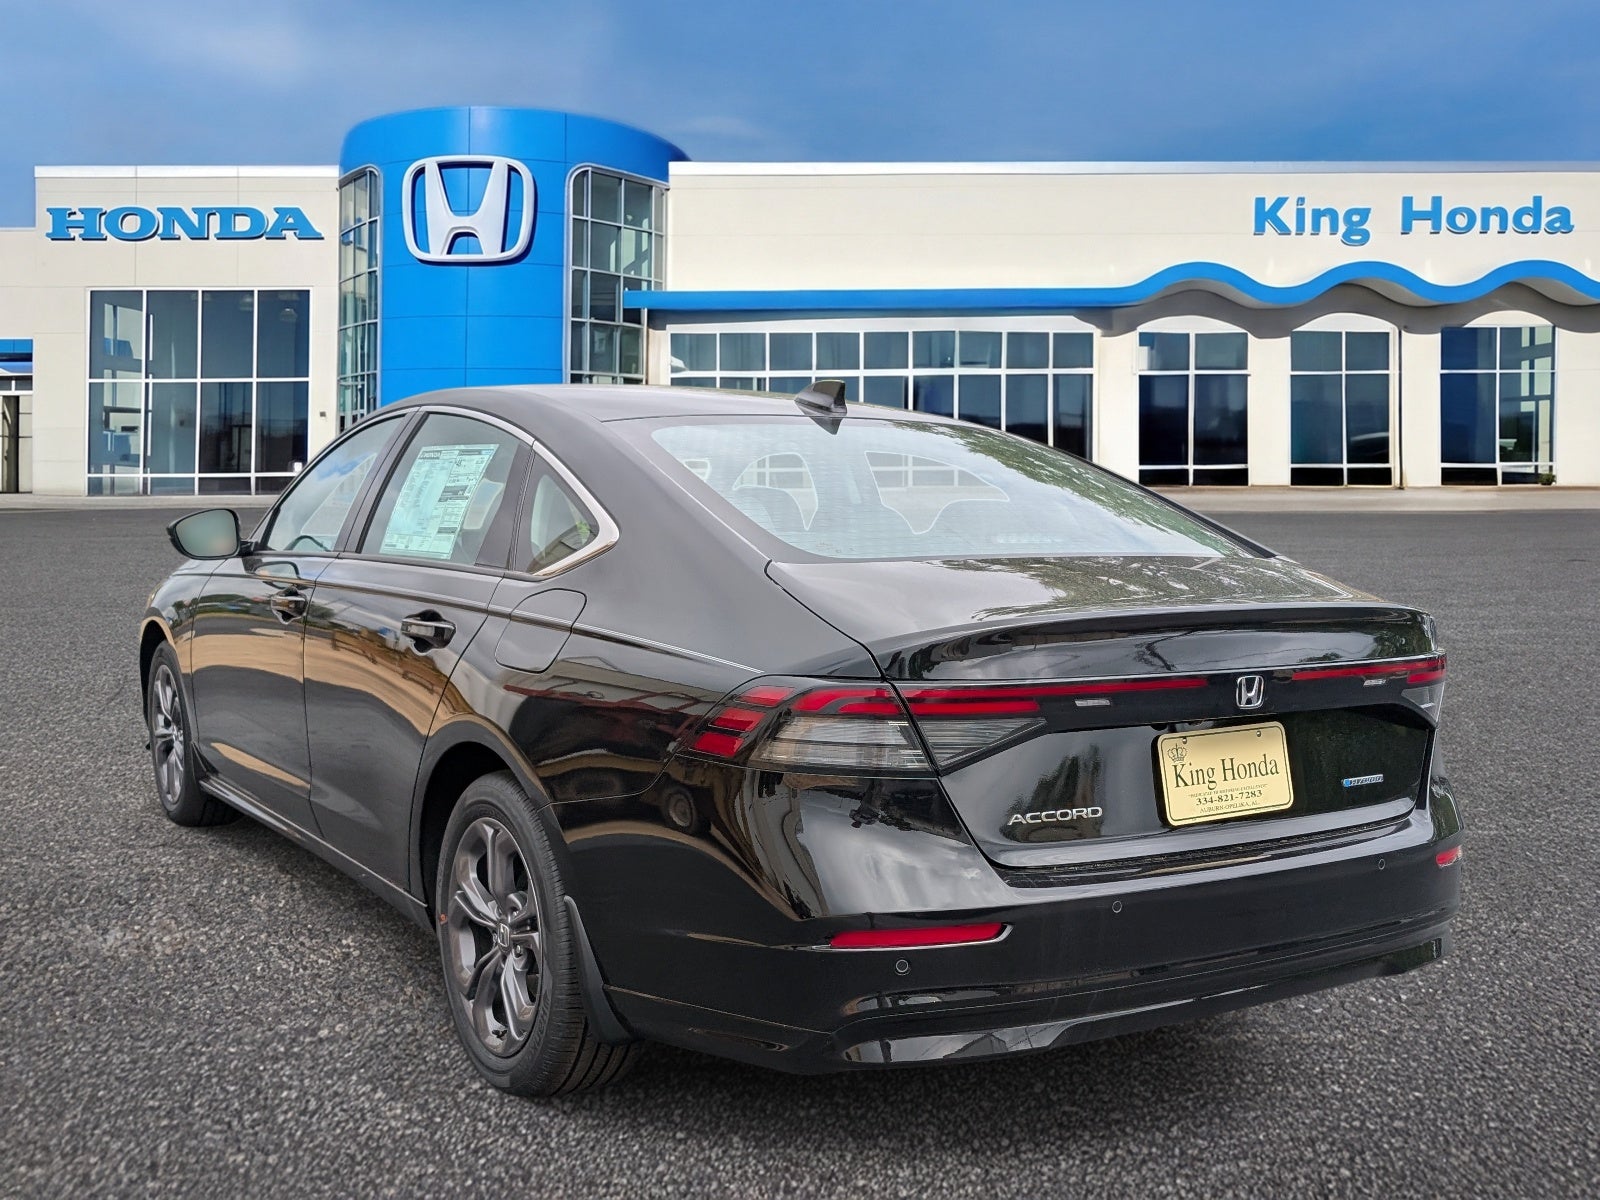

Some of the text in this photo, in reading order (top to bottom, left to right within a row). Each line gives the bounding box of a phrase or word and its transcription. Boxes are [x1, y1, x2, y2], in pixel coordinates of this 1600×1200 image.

[46, 206, 324, 241] HONDA
[1253, 195, 1575, 246] King Honda
[1172, 753, 1280, 790] King Honda
[1196, 789, 1263, 806] 334-821-7283
[1007, 807, 1103, 826] ACCORD
